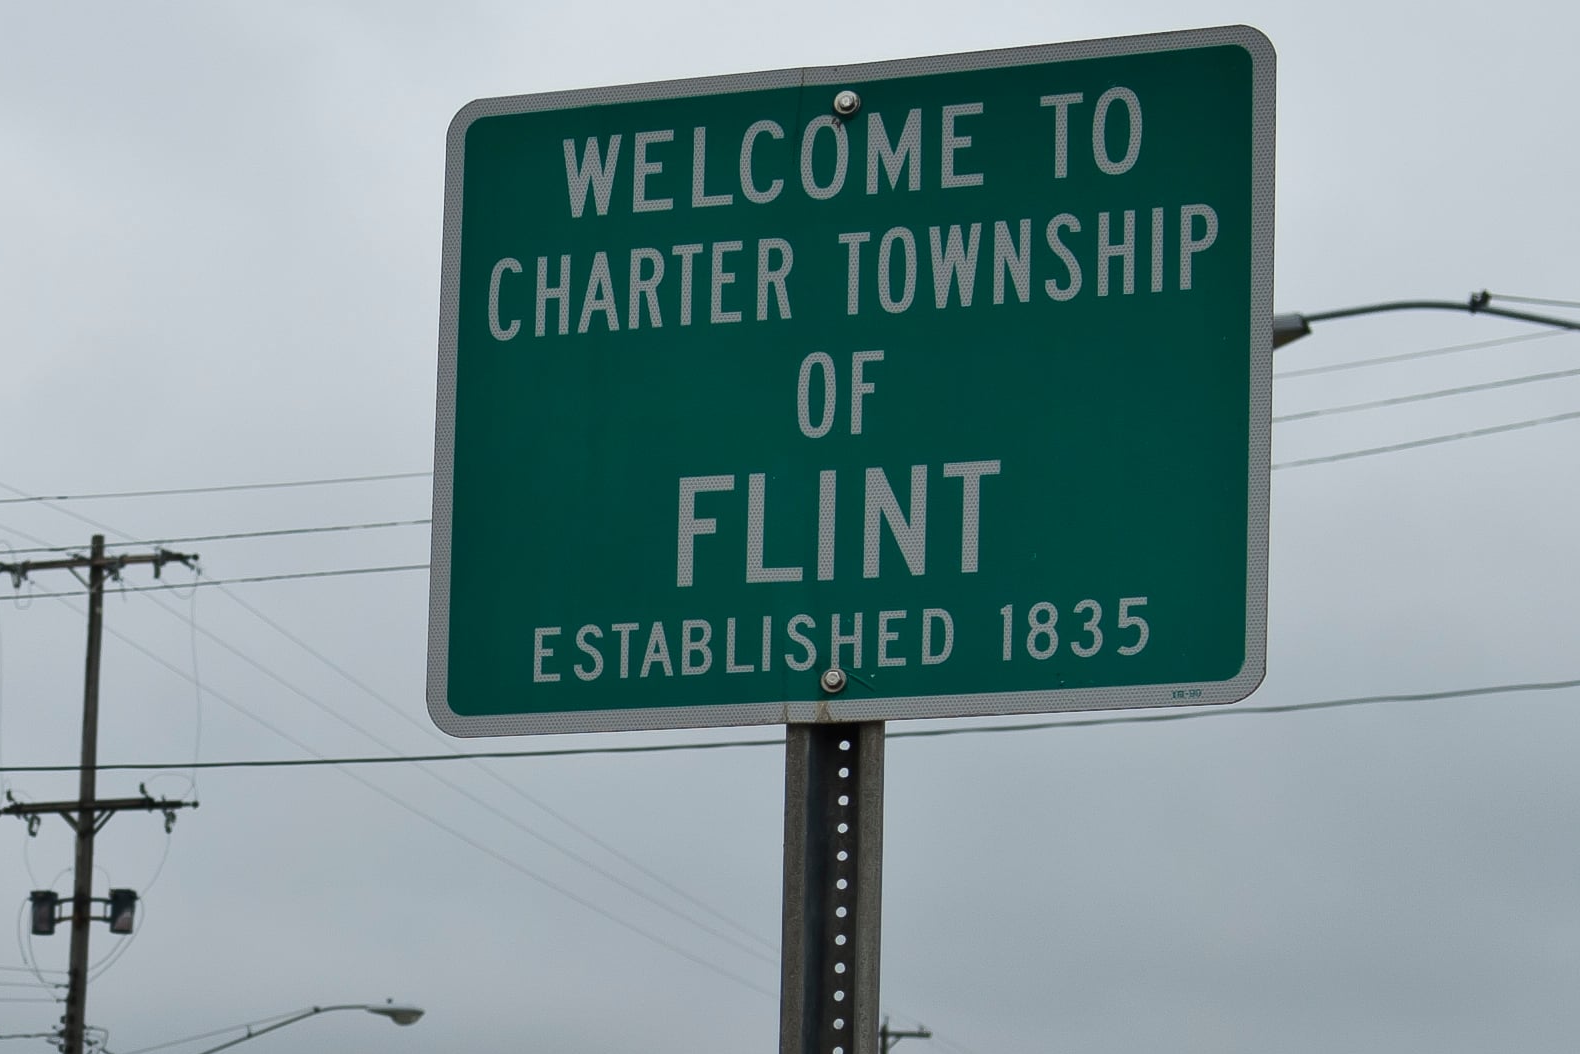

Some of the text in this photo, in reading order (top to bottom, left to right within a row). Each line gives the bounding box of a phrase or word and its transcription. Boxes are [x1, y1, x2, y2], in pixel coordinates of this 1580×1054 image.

[563, 87, 1142, 218] WELCOME TO
[488, 204, 1219, 341] CHARTER TOWNSHIP
[797, 350, 885, 438] OF
[677, 460, 1001, 587] FLINT
[533, 597, 1149, 682] ESTABLISHED 1835
